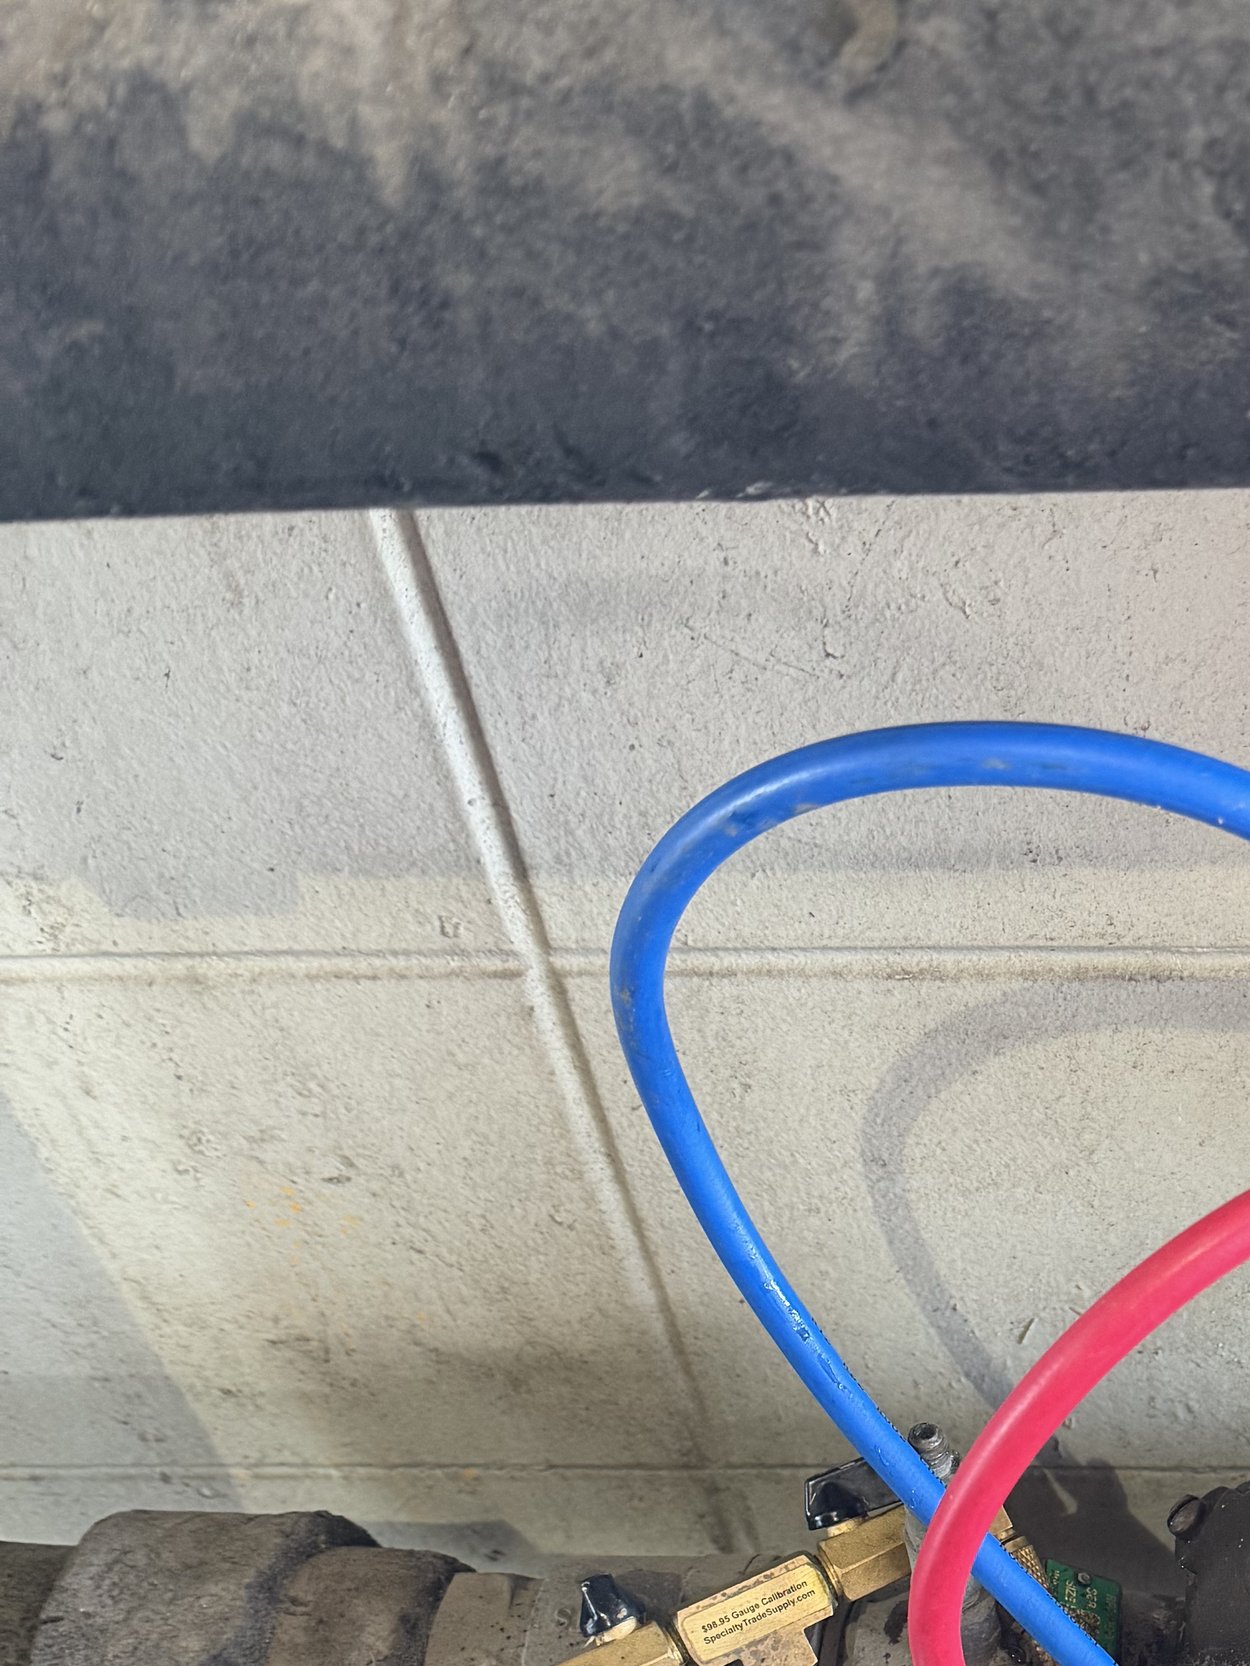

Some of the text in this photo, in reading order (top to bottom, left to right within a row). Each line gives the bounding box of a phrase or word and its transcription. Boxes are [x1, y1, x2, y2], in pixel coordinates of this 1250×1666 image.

[701, 1580, 808, 1633] $98.95 Gauge Calibration
[703, 1589, 816, 1645] SpecialtyTradeSupply.com
